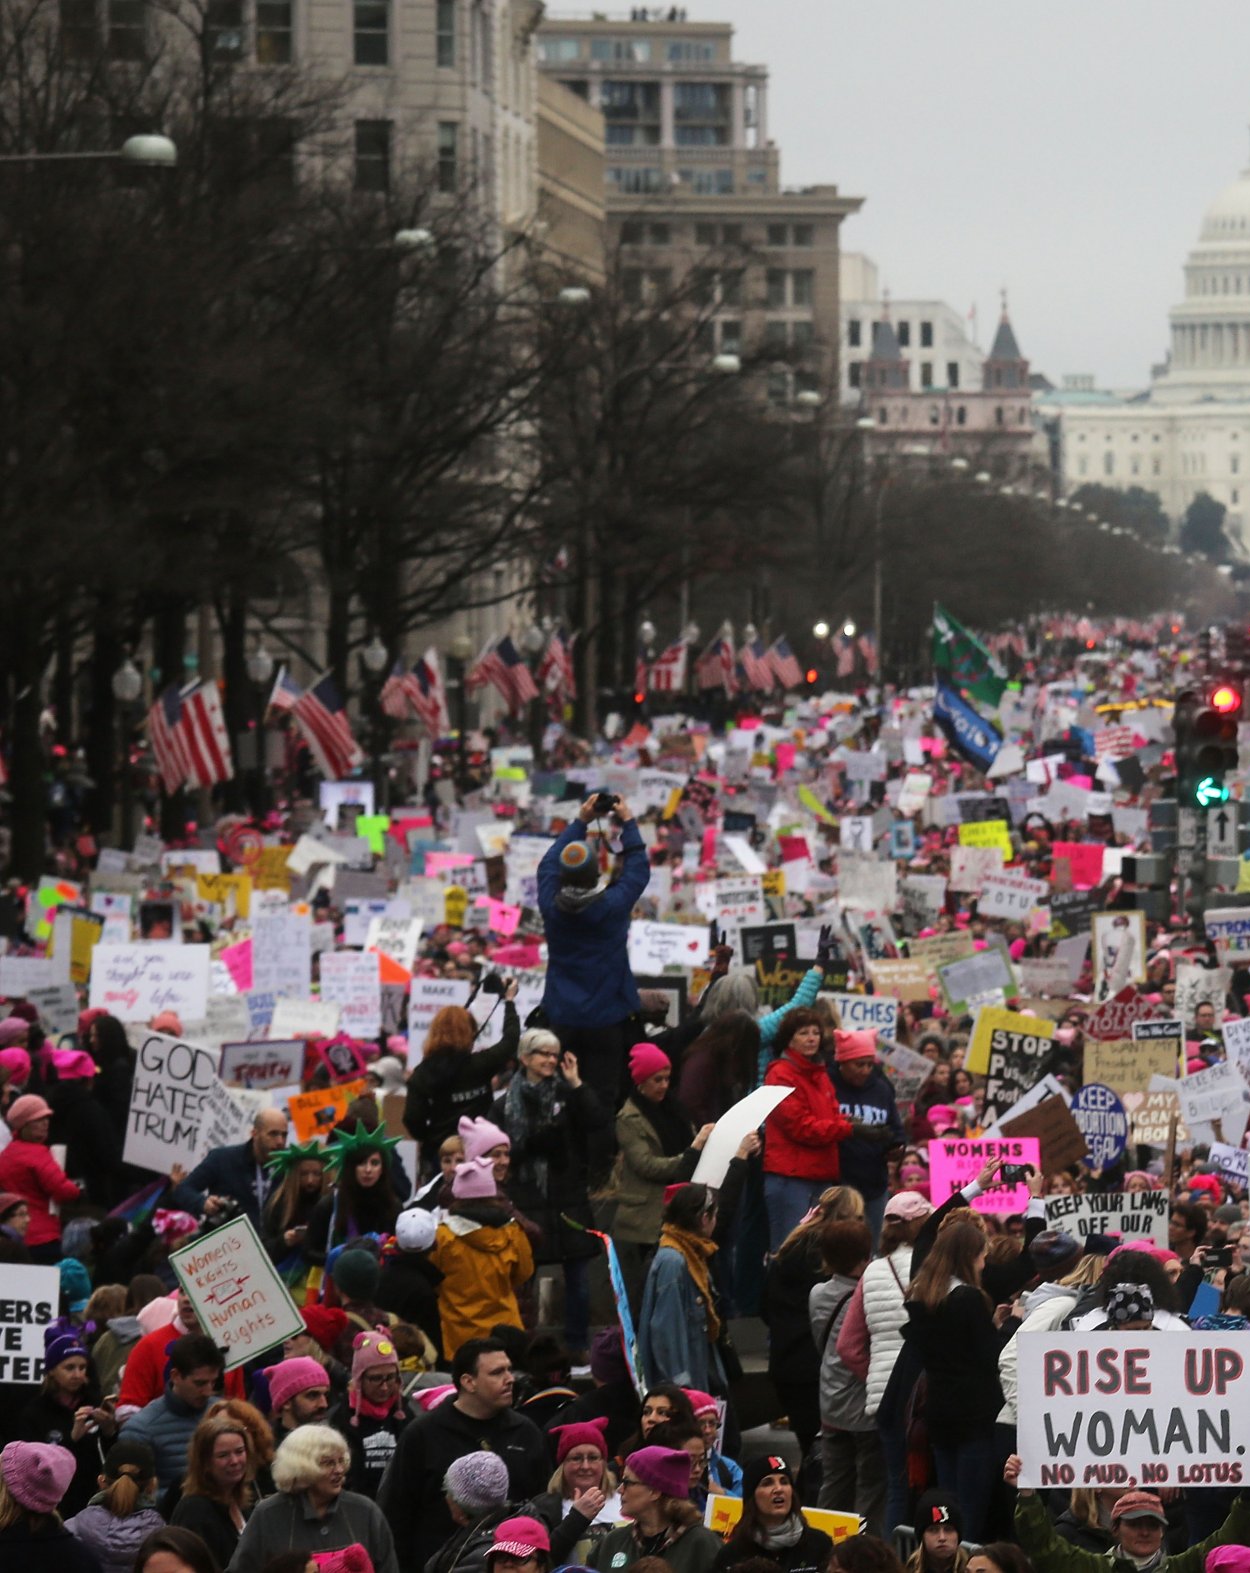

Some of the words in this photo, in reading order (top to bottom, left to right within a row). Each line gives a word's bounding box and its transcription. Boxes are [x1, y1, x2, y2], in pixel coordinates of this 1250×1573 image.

[840, 999, 895, 1024] TCHES
[992, 1030, 1052, 1057] STOP
[140, 1036, 216, 1091] GOD
[1078, 1086, 1116, 1110] KEEP
[1147, 1094, 1175, 1108] MY
[943, 1143, 1023, 1158] WOMENS
[1046, 1194, 1084, 1221] KEEP
[1084, 1195, 1125, 1215] YOUR
[1130, 1191, 1169, 1216] LAWS
[1077, 1217, 1109, 1237] OFF
[1120, 1214, 1154, 1233] OUR
[181, 1235, 242, 1277] Women's
[207, 1289, 267, 1328] Human
[0, 1327, 22, 1351] E
[221, 1312, 276, 1348] Rights
[1043, 1348, 1152, 1397] RISE
[1184, 1347, 1244, 1396] UP
[1043, 1407, 1247, 1457] WOMAN.
[1041, 1462, 1076, 1485] NO
[1083, 1462, 1138, 1488] MUD,
[1141, 1462, 1169, 1485] NO
[1178, 1461, 1243, 1484] LOTUS
